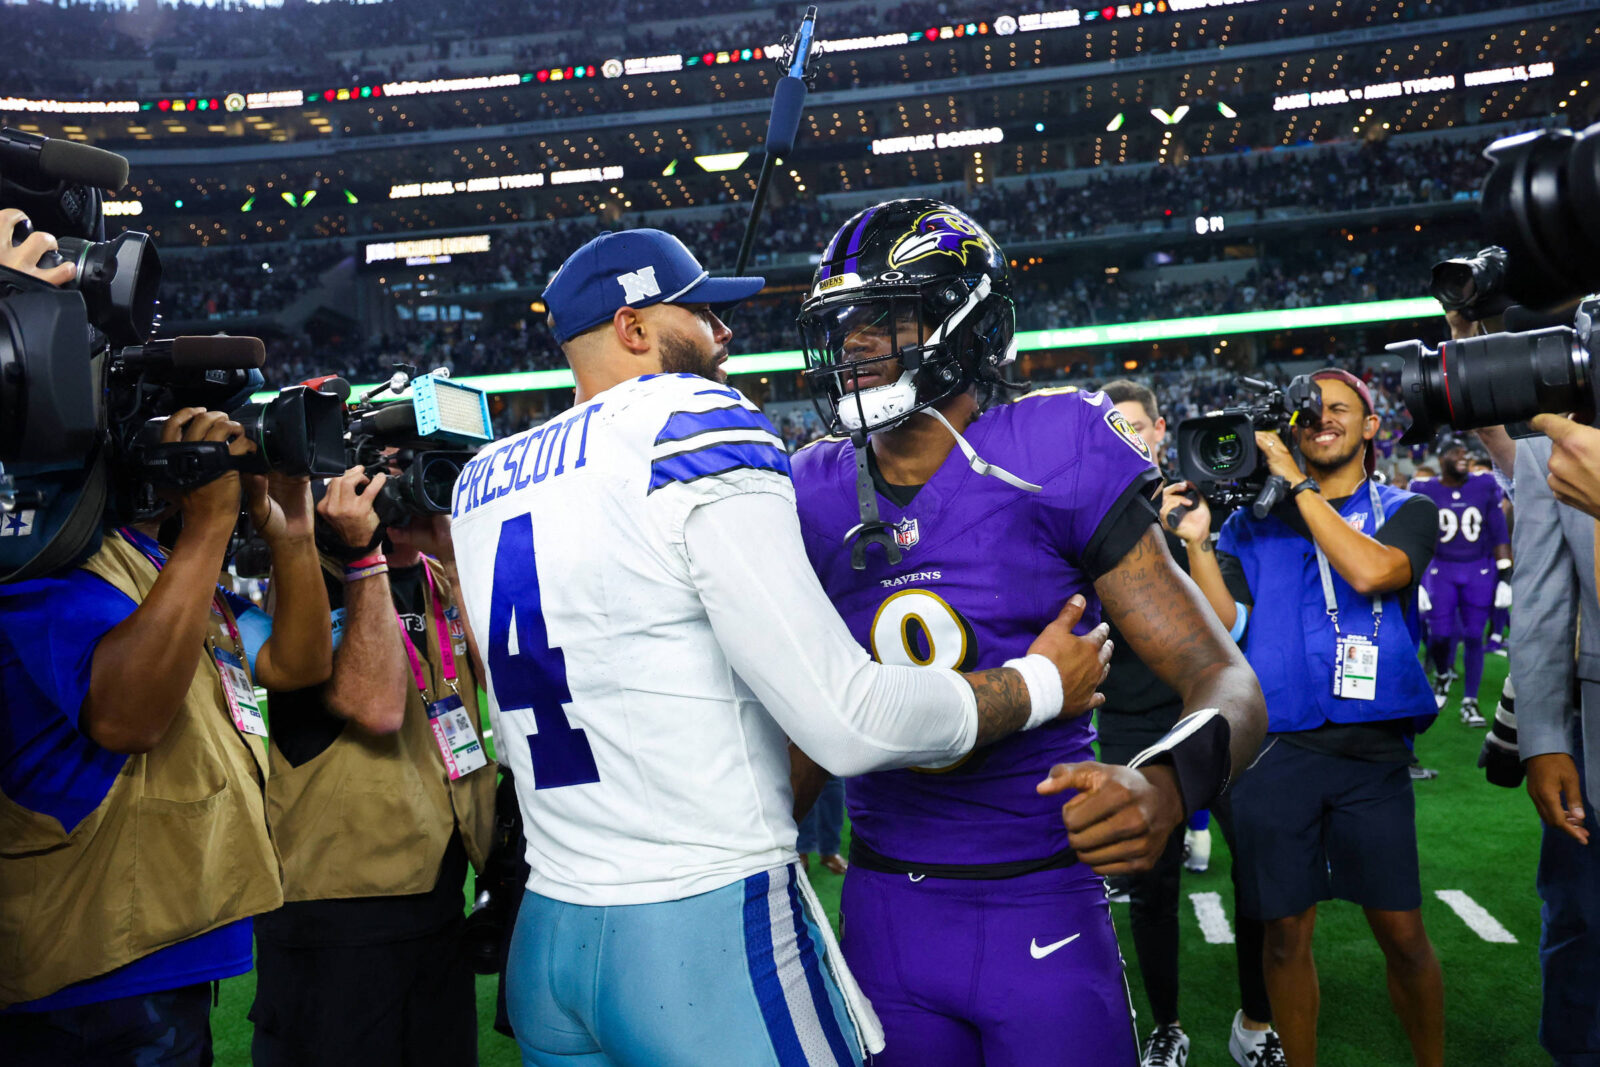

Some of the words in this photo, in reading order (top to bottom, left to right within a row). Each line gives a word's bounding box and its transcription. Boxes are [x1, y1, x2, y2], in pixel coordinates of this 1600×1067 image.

[1273, 93, 1309, 110] JAKE
[1310, 89, 1349, 106] PAUL
[1364, 82, 1402, 99] MIKE
[1402, 75, 1455, 94] TYSON
[872, 133, 936, 155] NETFLIX
[936, 126, 1004, 148] BOXING
[616, 265, 662, 305] N
[818, 275, 845, 291] RAVENS
[452, 402, 604, 519] PRESCOTT
[897, 529, 917, 546] NFL
[1438, 506, 1482, 543] 90
[880, 570, 942, 588] RAVENS
[487, 511, 601, 791] 4
[432, 722, 457, 776] MEDIA
